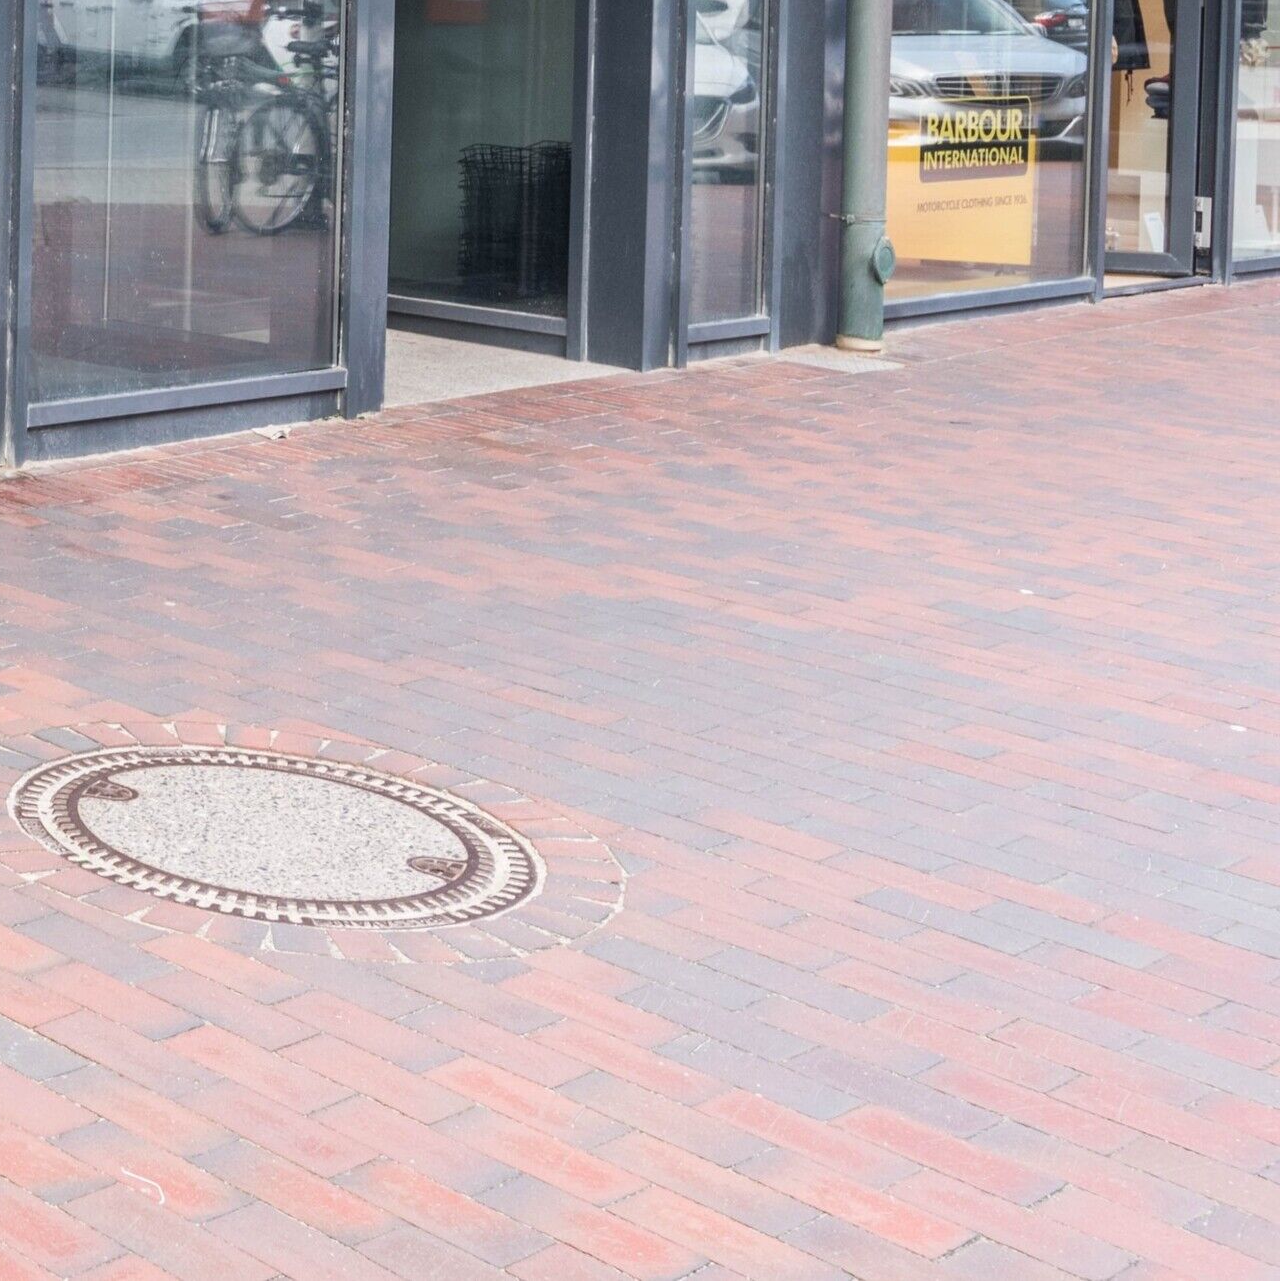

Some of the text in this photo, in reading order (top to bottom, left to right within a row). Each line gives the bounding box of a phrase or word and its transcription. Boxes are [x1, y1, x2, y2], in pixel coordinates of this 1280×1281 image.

[927, 109, 1023, 145] BARBOUR
[924, 146, 1024, 170] INTERNATIONAL
[917, 199, 960, 213] MOTORCYCLE
[961, 196, 993, 208] CLOTHING
[994, 194, 1013, 206] SINCE
